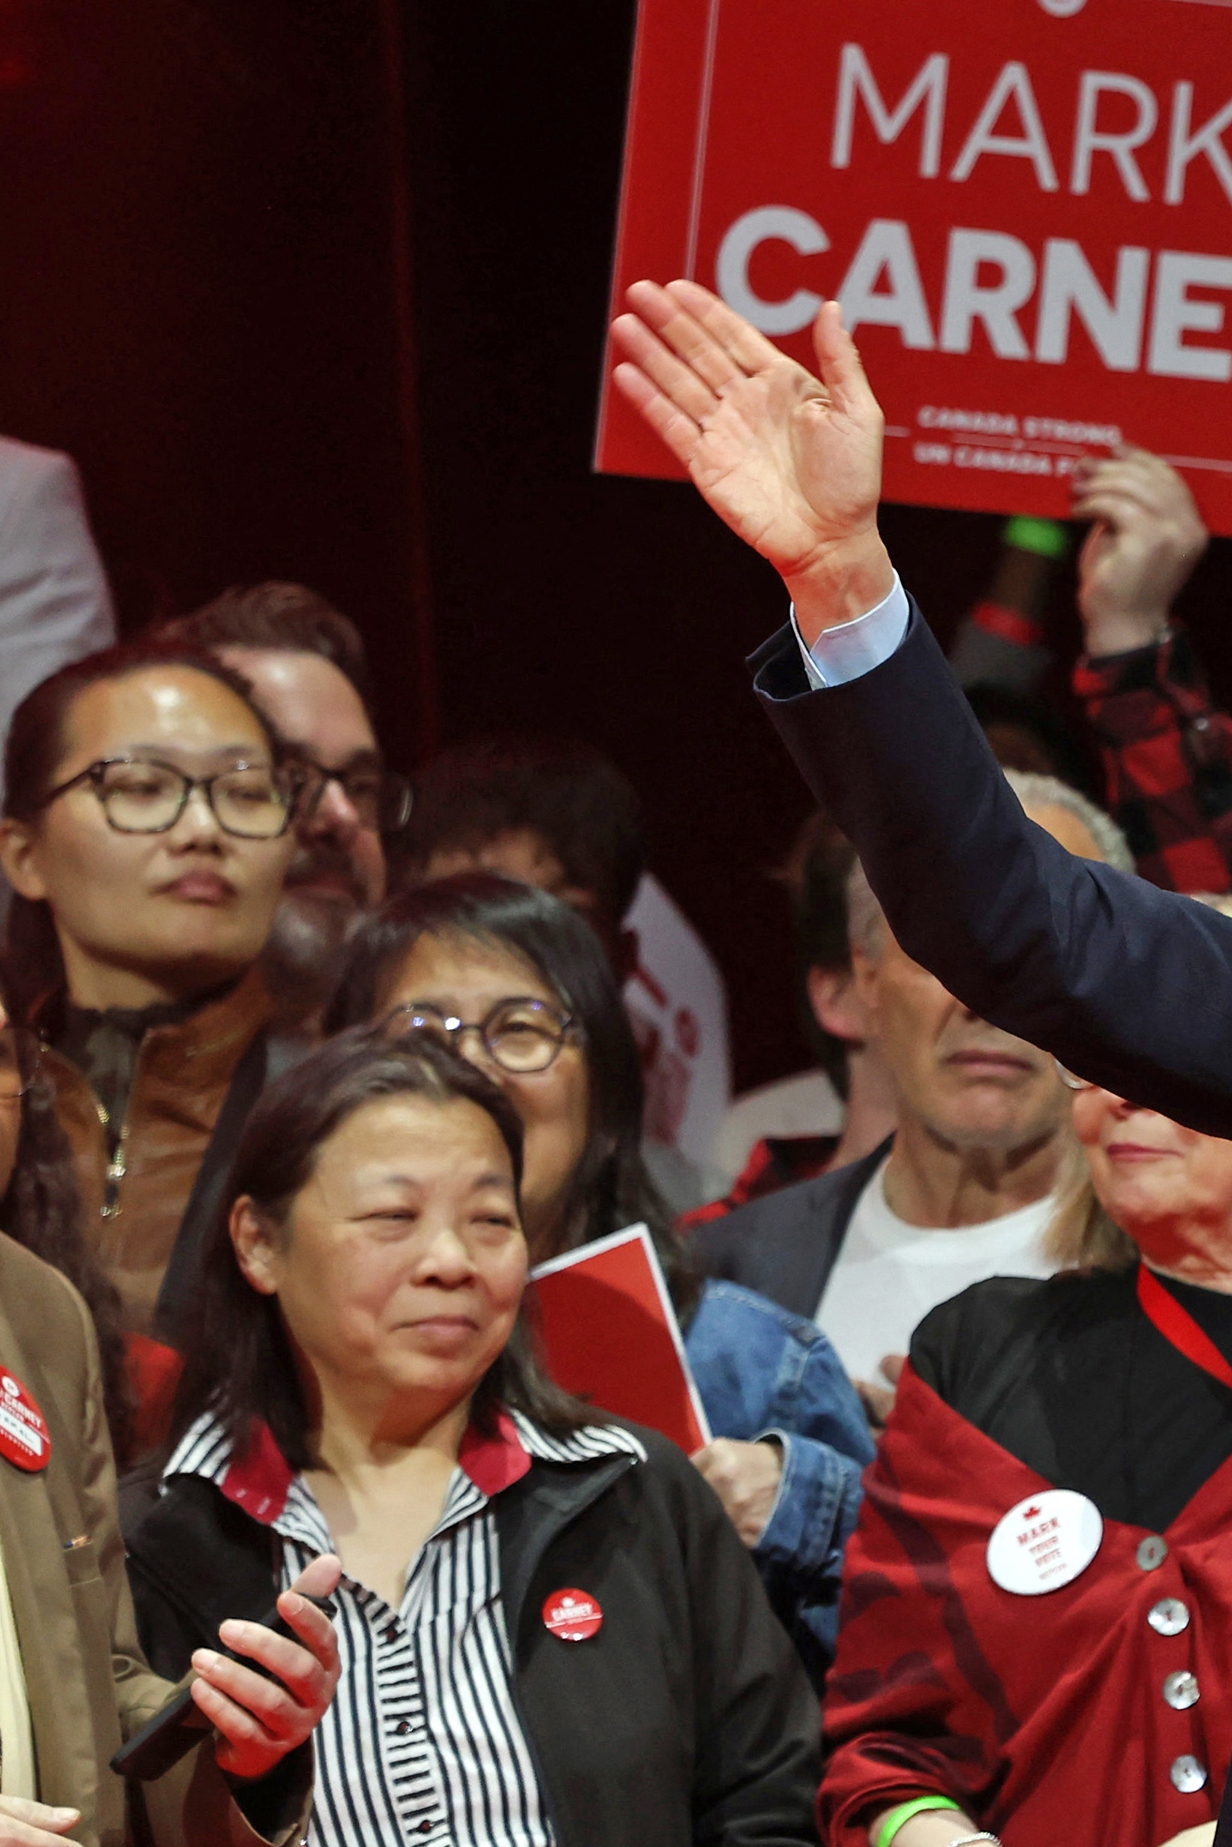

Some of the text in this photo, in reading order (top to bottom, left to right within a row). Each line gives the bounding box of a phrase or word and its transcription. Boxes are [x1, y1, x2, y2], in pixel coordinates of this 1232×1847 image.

[917, 405, 1121, 447] CANADA STRONG
[913, 441, 951, 465] UN
[952, 446, 1052, 475] CANADA
[1017, 1517, 1060, 1546] MARK
